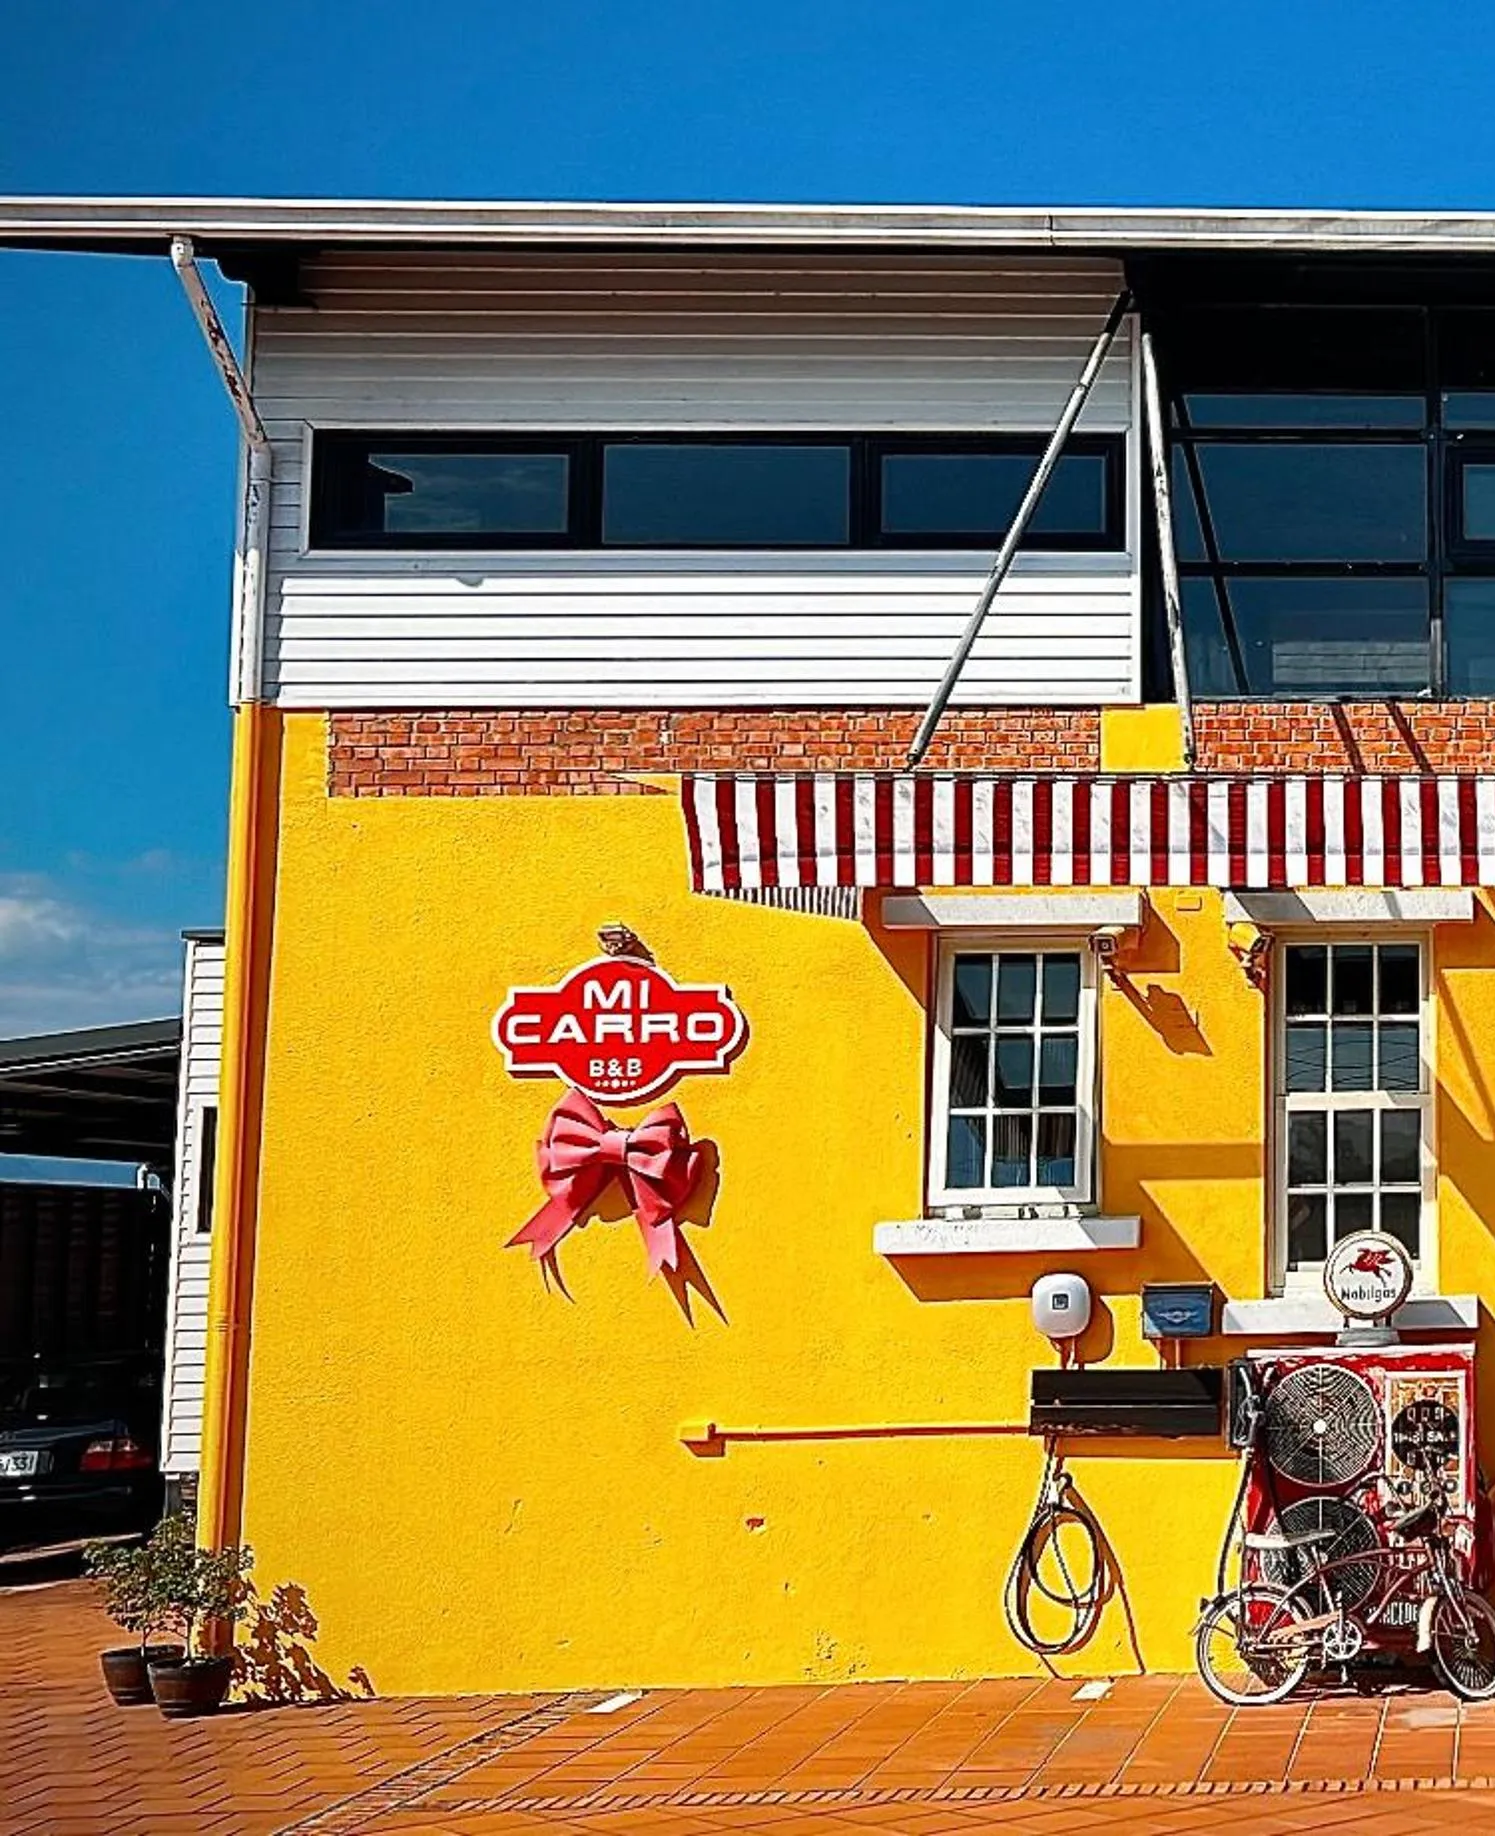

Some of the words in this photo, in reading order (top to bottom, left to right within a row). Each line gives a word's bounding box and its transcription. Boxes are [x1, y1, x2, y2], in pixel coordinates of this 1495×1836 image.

[583, 979, 651, 1010] MI
[506, 1012, 725, 1044] CARRO
[589, 1058, 643, 1078] B&B
[1341, 1285, 1396, 1303] Mobilgas
